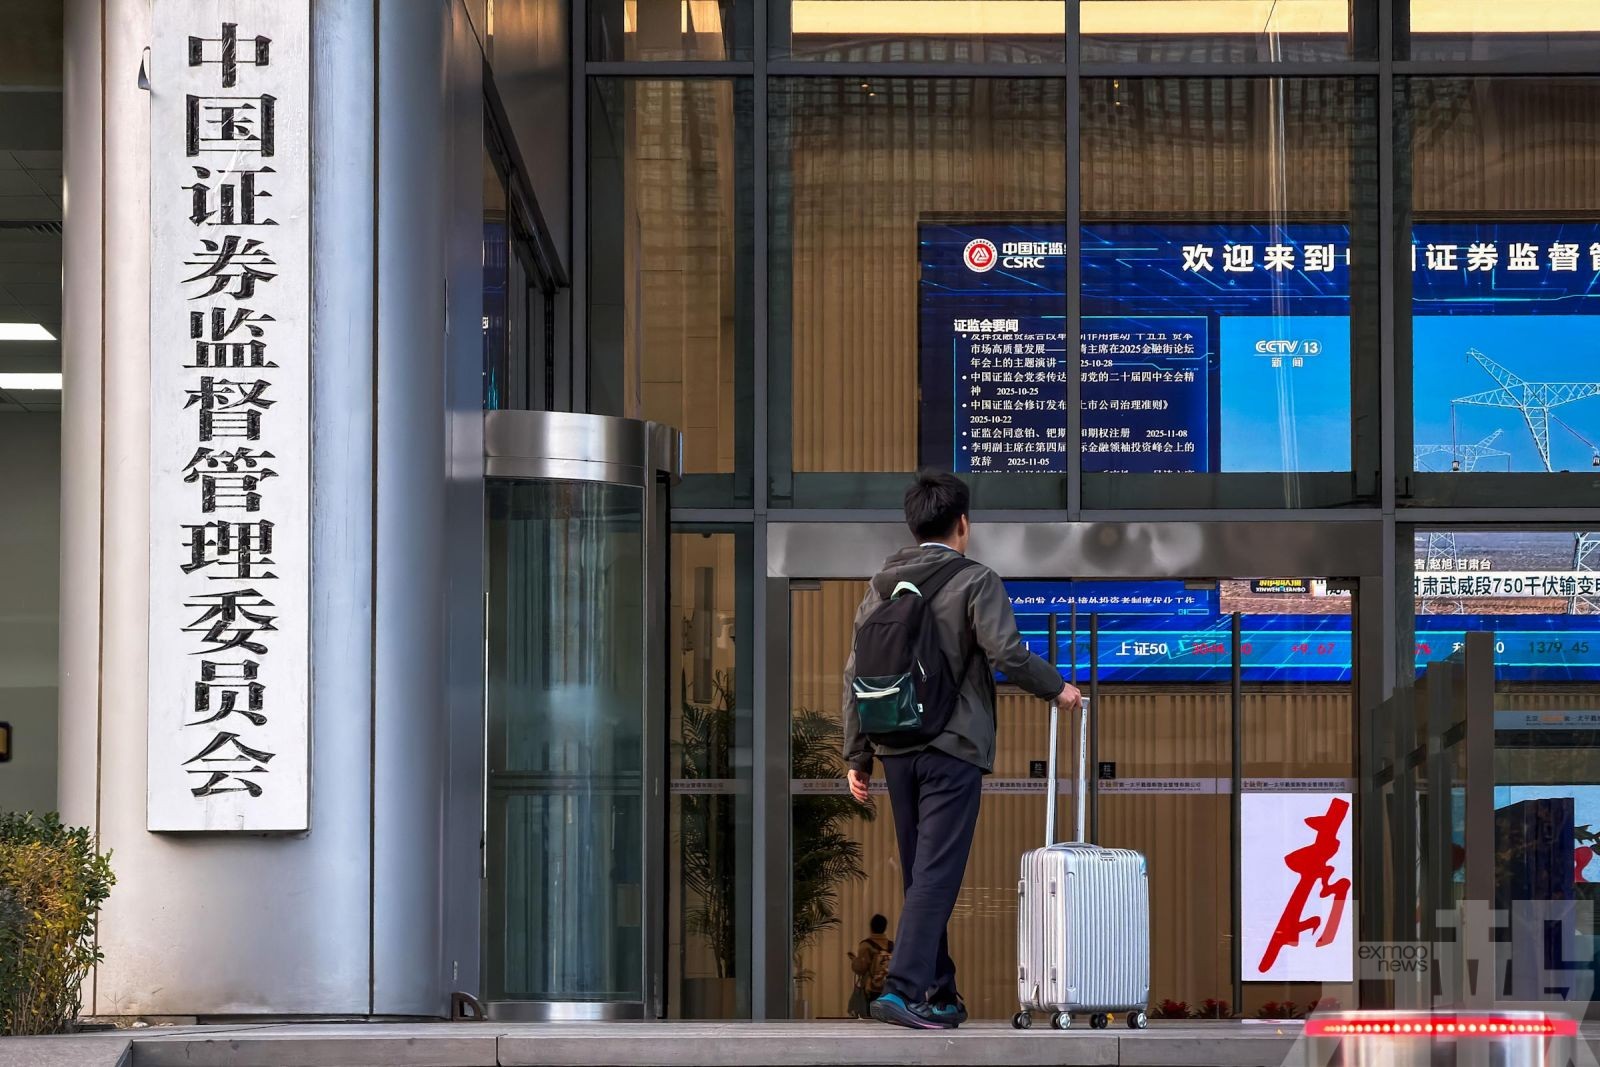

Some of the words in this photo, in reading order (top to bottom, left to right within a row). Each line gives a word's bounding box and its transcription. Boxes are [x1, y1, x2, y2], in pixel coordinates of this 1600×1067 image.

[1003, 242, 1066, 255] 中国证监
[1003, 257, 1045, 268] CSRC
[1182, 242, 1600, 271] 欢迎来到证券监督
[954, 319, 1018, 332] 证监会要闻
[1256, 341, 1298, 352] CCTV
[1304, 342, 1318, 353] 13
[971, 358, 1056, 368] 年会上的主题演讲
[971, 386, 981, 396] 神
[181, 22, 279, 798] 中国证券监督管理委员会
[971, 456, 992, 466] 致辞
[1430, 559, 1452, 570] 赵旭
[1457, 559, 1491, 570] 甘肃台
[1116, 641, 1167, 656] 上证50
